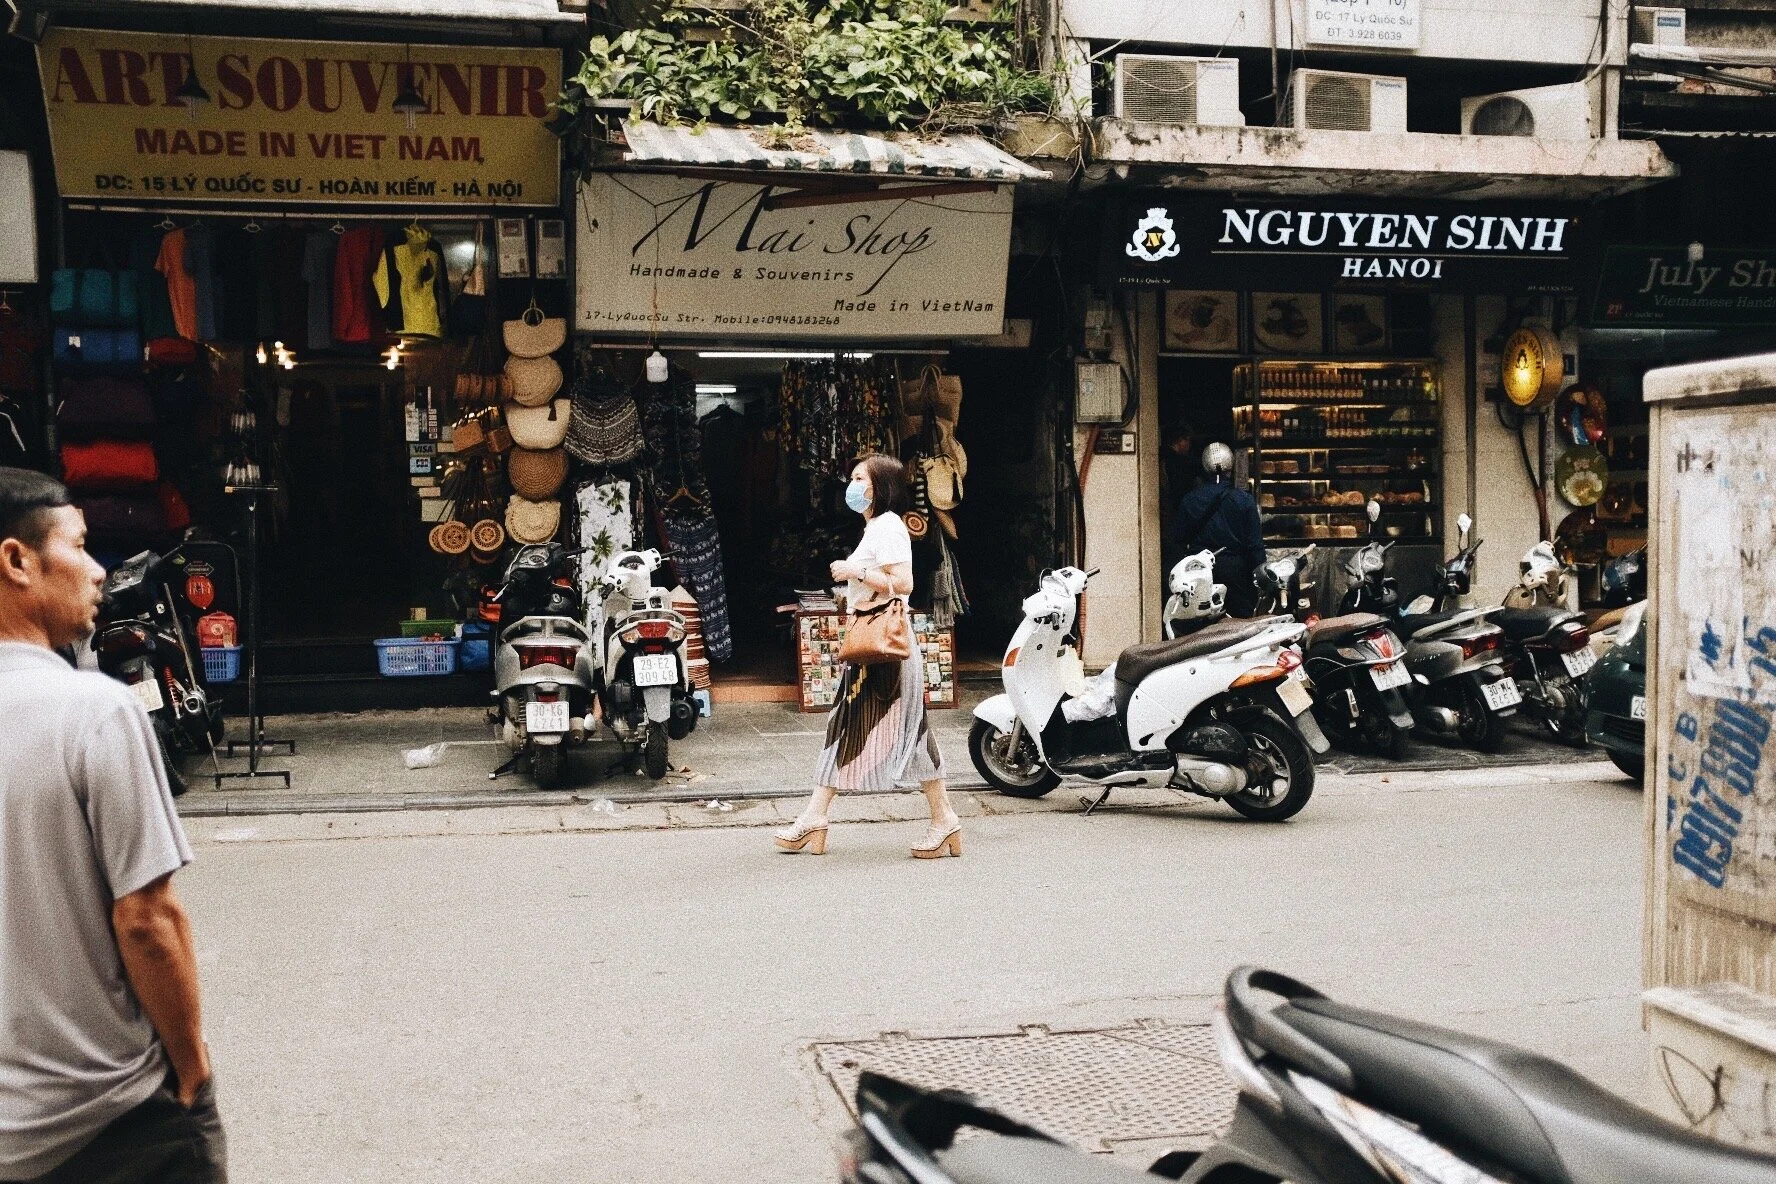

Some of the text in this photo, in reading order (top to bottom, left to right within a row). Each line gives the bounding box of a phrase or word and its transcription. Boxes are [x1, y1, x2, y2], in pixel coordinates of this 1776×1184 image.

[1339, 13, 1350, 21] 17
[1378, 31, 1402, 41] 6039
[52, 47, 551, 119] ART SOUVENIR
[134, 127, 247, 156] MADE
[258, 130, 296, 157] IN
[307, 132, 387, 160] VIET
[140, 175, 166, 191] 15
[172, 172, 199, 192] LÝ
[204, 171, 266, 193] QUỐC
[319, 176, 380, 196] HOÀN
[453, 178, 482, 197] HÀ
[487, 179, 523, 201] NỘI
[631, 181, 938, 298] Mai Shop
[1217, 208, 1570, 252] NGUYEN SINH
[629, 263, 855, 281] Handmade & Souvenirs
[1340, 257, 1445, 279] HANOI
[1638, 257, 1722, 294] July
[833, 299, 994, 313] Made in VietNam
[1653, 294, 1734, 308] Vietnamese
[414, 445, 433, 453] VISA
